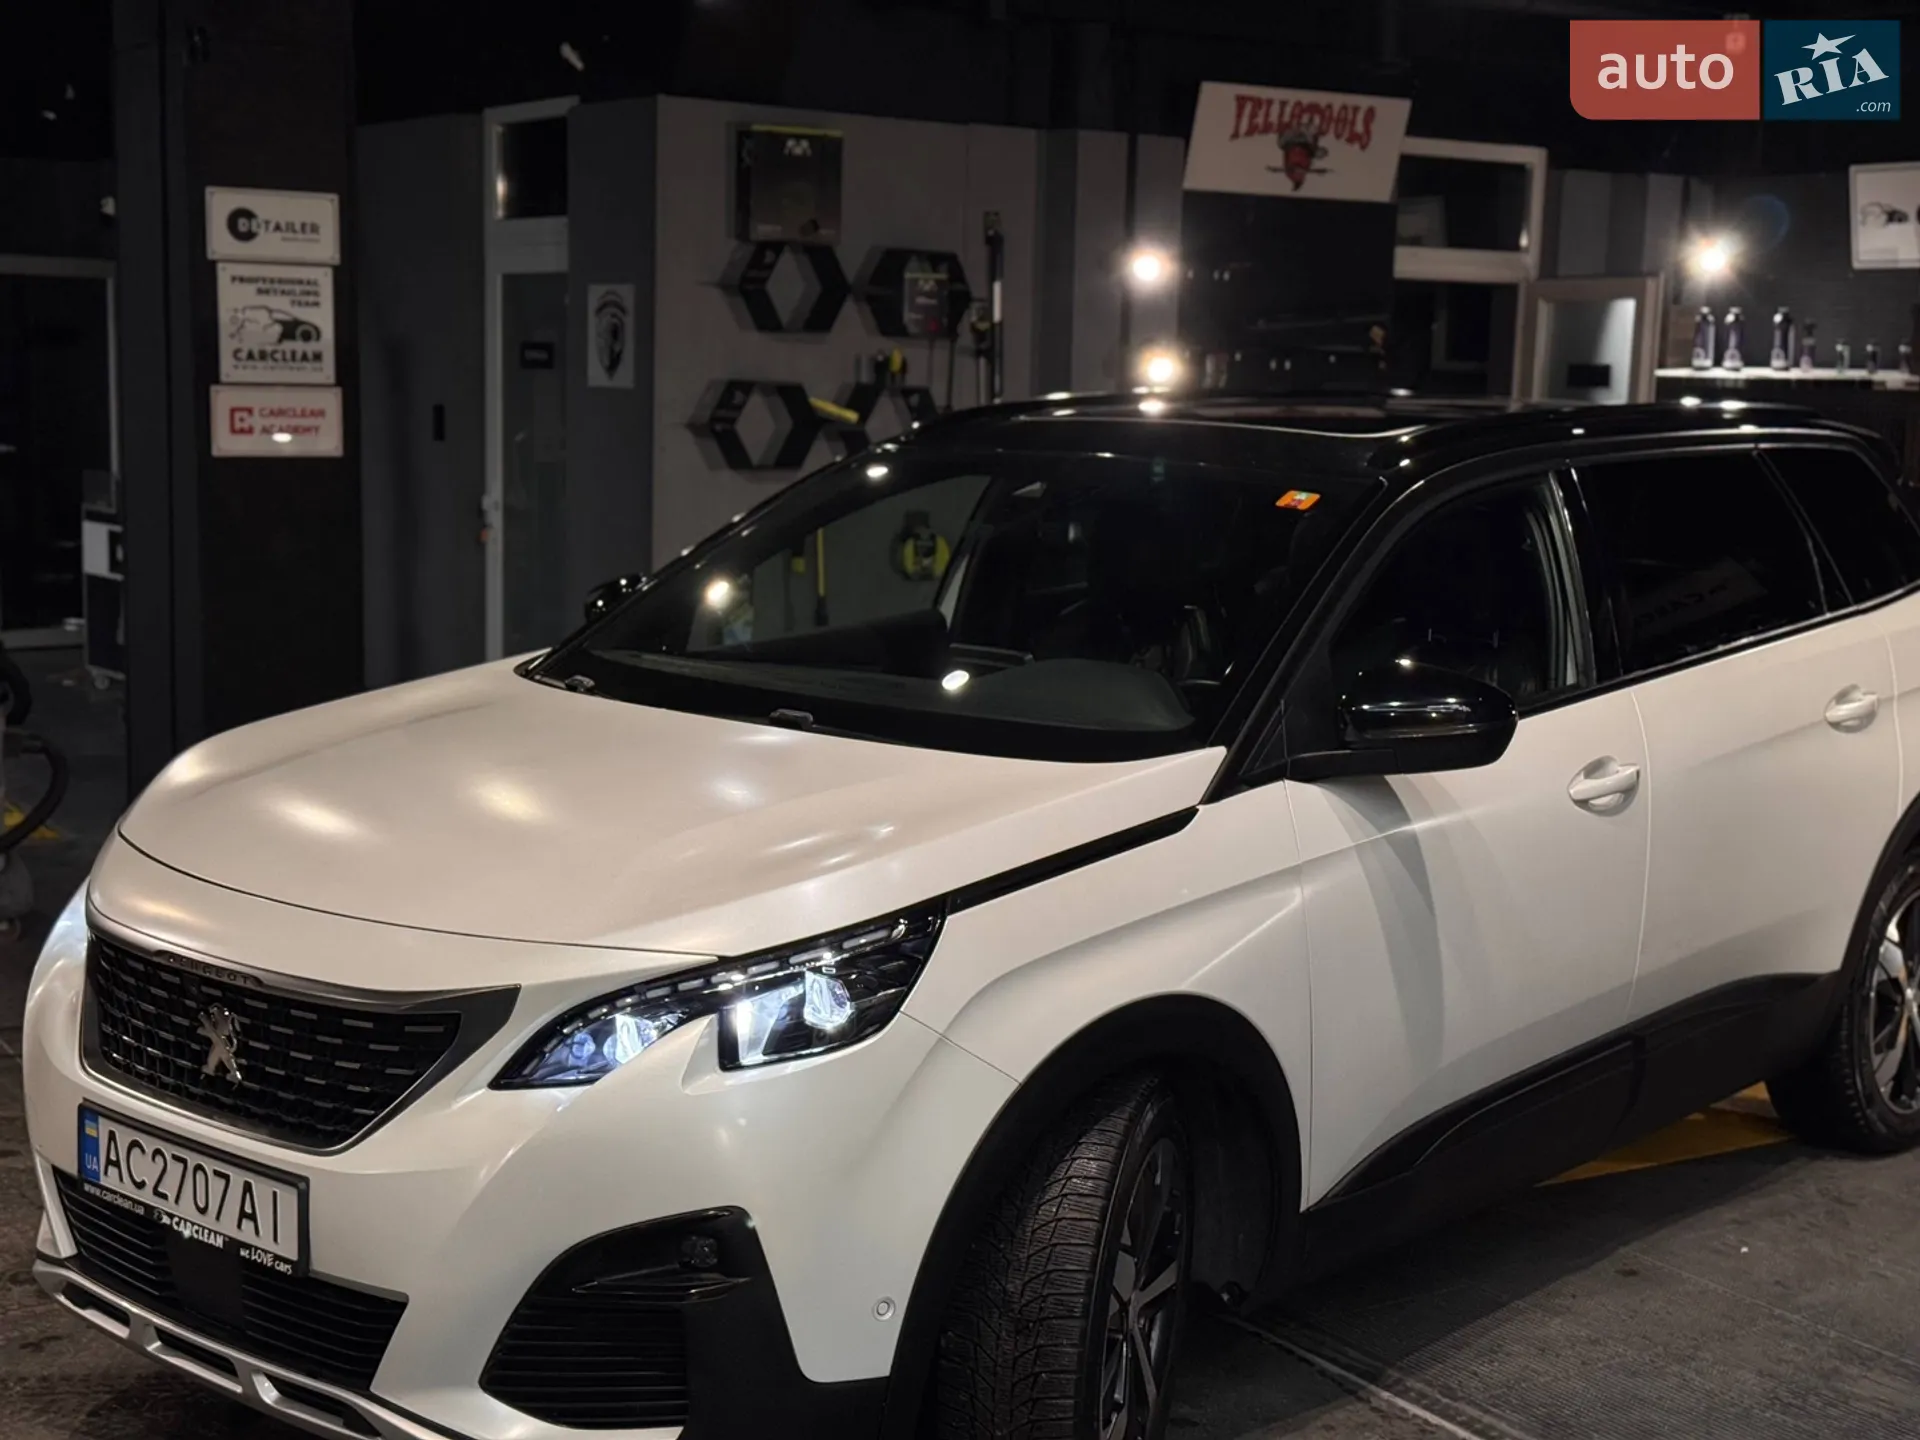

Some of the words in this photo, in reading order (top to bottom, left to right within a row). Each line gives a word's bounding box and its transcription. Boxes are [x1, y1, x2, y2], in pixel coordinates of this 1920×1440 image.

[1229, 94, 1376, 151] YELLOTOOLS
[232, 348, 323, 362] CARCLEAN
[258, 407, 326, 420] CARCLEAN
[260, 424, 320, 437] ACADEMY
[84, 1153, 100, 1173] UA
[103, 1129, 280, 1244] AC2707AI
[172, 1216, 224, 1249] CARCLEAN
[251, 1247, 274, 1267] LOVE
[274, 1260, 293, 1275] cars
